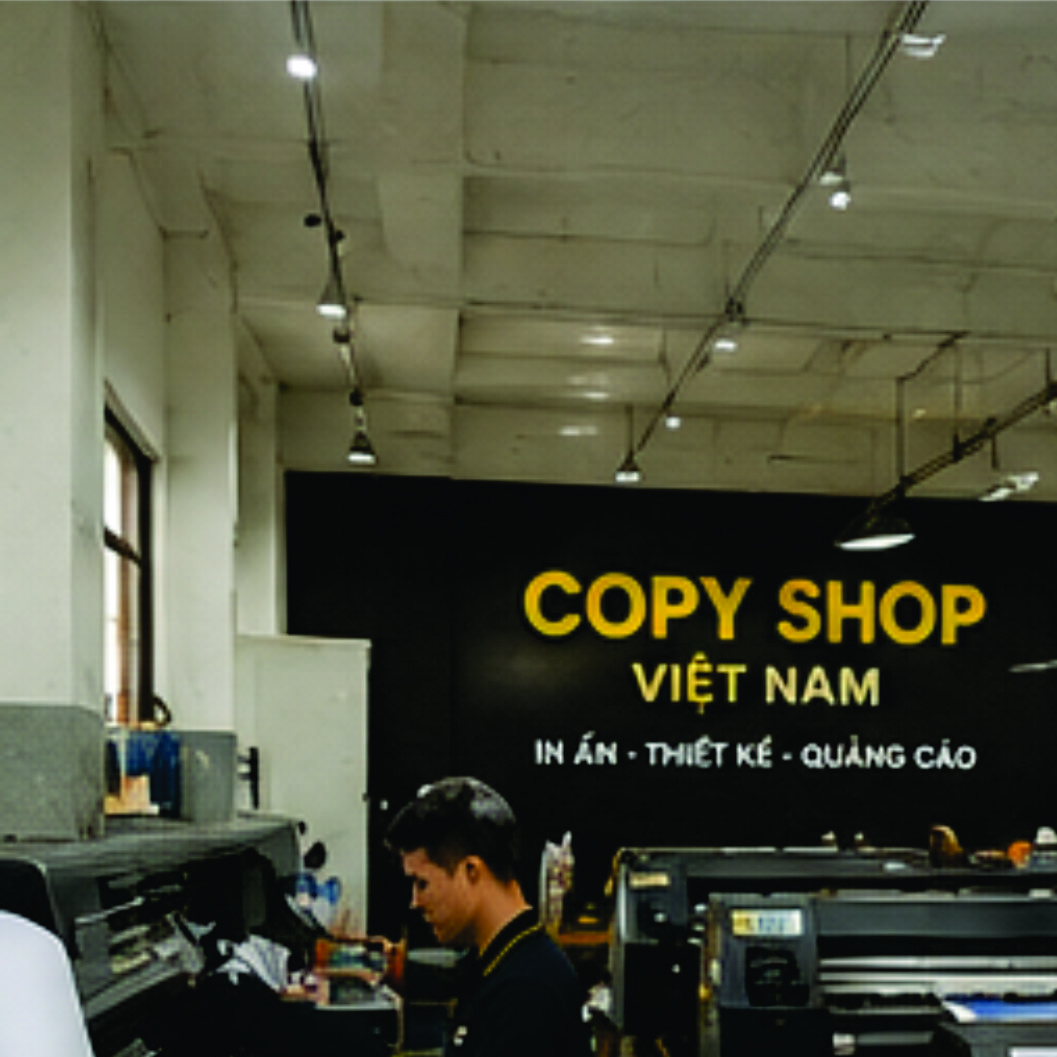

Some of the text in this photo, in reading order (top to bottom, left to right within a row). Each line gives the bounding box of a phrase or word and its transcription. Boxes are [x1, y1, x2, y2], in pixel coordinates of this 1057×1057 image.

[523, 570, 987, 645] COPY SHOP
[631, 652, 880, 714] VIỆT NAM
[535, 739, 564, 765] IN
